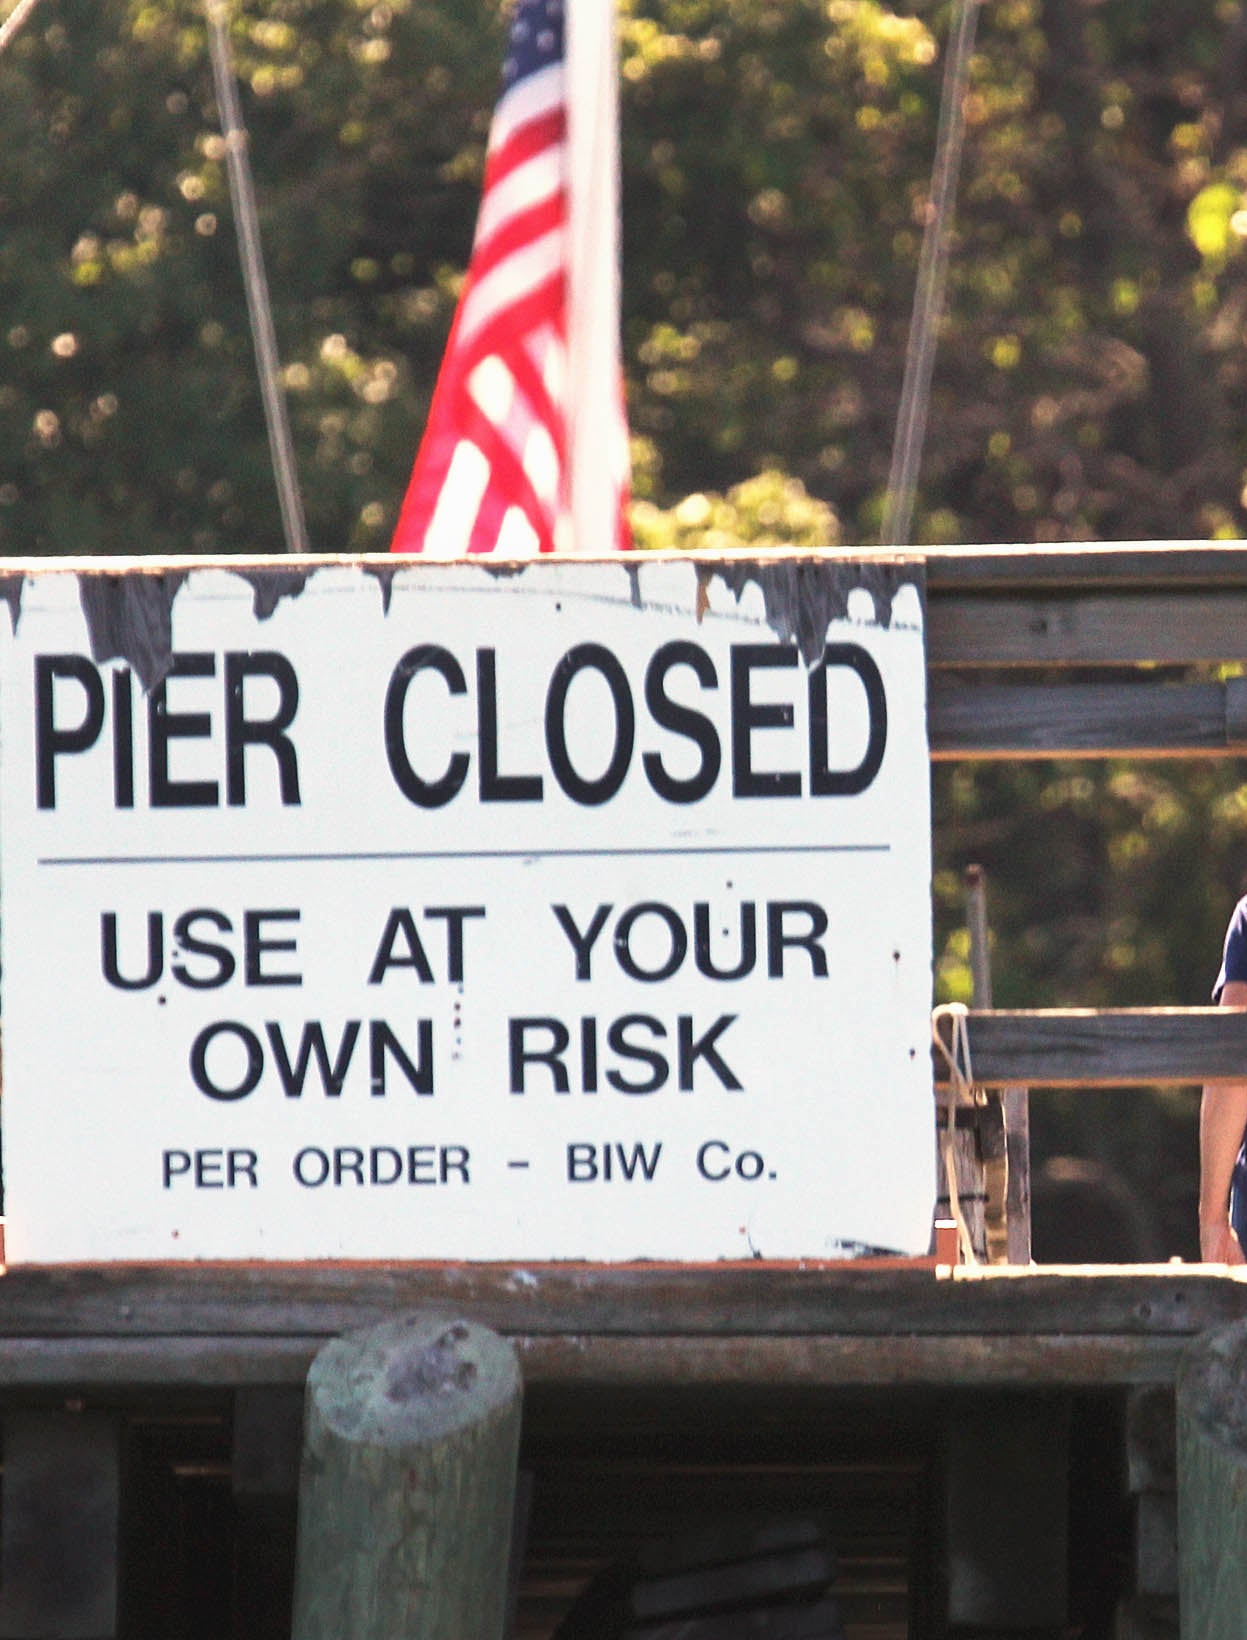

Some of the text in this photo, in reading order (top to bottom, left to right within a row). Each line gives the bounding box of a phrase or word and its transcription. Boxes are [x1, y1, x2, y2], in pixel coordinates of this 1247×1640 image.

[34, 641, 889, 810] PIER CLOSED
[101, 901, 830, 991] USE AT YOUR
[189, 1013, 745, 1102] OWN RISK
[162, 1149, 259, 1189] PER
[293, 1146, 471, 1187] ORDER
[567, 1142, 663, 1182] BIW
[696, 1141, 778, 1181] Co.
